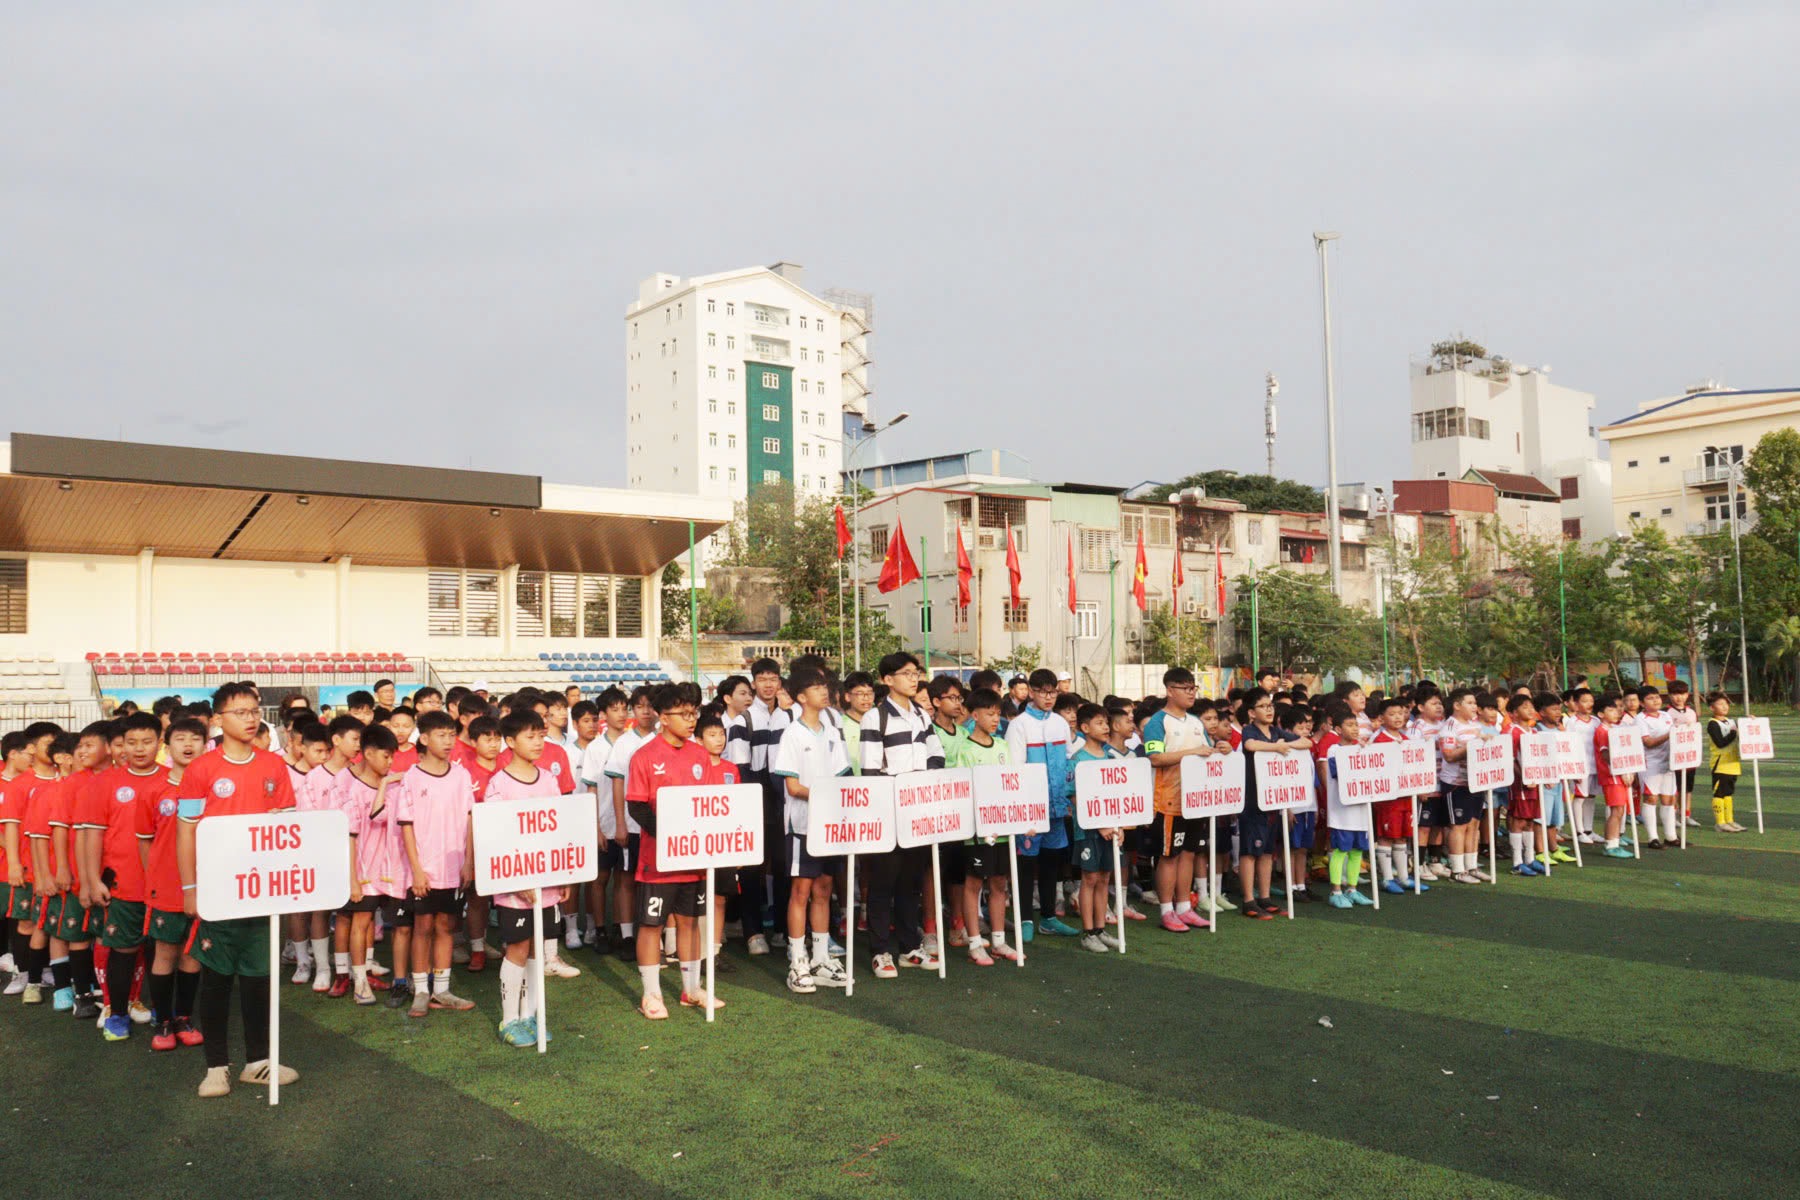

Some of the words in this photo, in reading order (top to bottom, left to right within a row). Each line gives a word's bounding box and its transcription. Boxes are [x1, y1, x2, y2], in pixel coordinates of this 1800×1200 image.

[1147, 742, 1155, 751] C
[1491, 745, 1503, 761] HỌC
[1206, 760, 1223, 777] THCS
[1267, 755, 1283, 776] TIỂU
[1285, 760, 1299, 778] HỌC
[1348, 749, 1366, 770] TIỂU
[1368, 753, 1385, 771] HỌC
[1001, 773, 1019, 791] THCS
[1100, 766, 1127, 784] THCS
[840, 787, 869, 807] THCS
[917, 785, 932, 804] TNCS
[954, 781, 970, 799] MINH
[1186, 785, 1213, 808] NGUYỄN
[1214, 786, 1223, 806] BÁ
[1225, 787, 1242, 807] NGỌC
[1359, 780, 1372, 798] THỊ
[692, 795, 730, 817] THCS
[1008, 801, 1027, 822] CÔNG
[1028, 803, 1046, 824] ĐỊNH
[1087, 796, 1100, 817] VÕ
[1104, 798, 1120, 819] THỊ
[1123, 793, 1144, 814] SÁU
[517, 809, 557, 834] THCS
[824, 816, 856, 843] TRẦN
[860, 817, 882, 841] PHÚ
[248, 824, 301, 851] THCS
[667, 830, 699, 857] NGÔ
[705, 825, 753, 856] QUYỀN
[490, 849, 546, 880] HOÀNG
[551, 842, 585, 875] DIỆU
[235, 867, 260, 900] TÔ
[269, 864, 315, 900] HIỆU
[647, 896, 663, 917] 21
